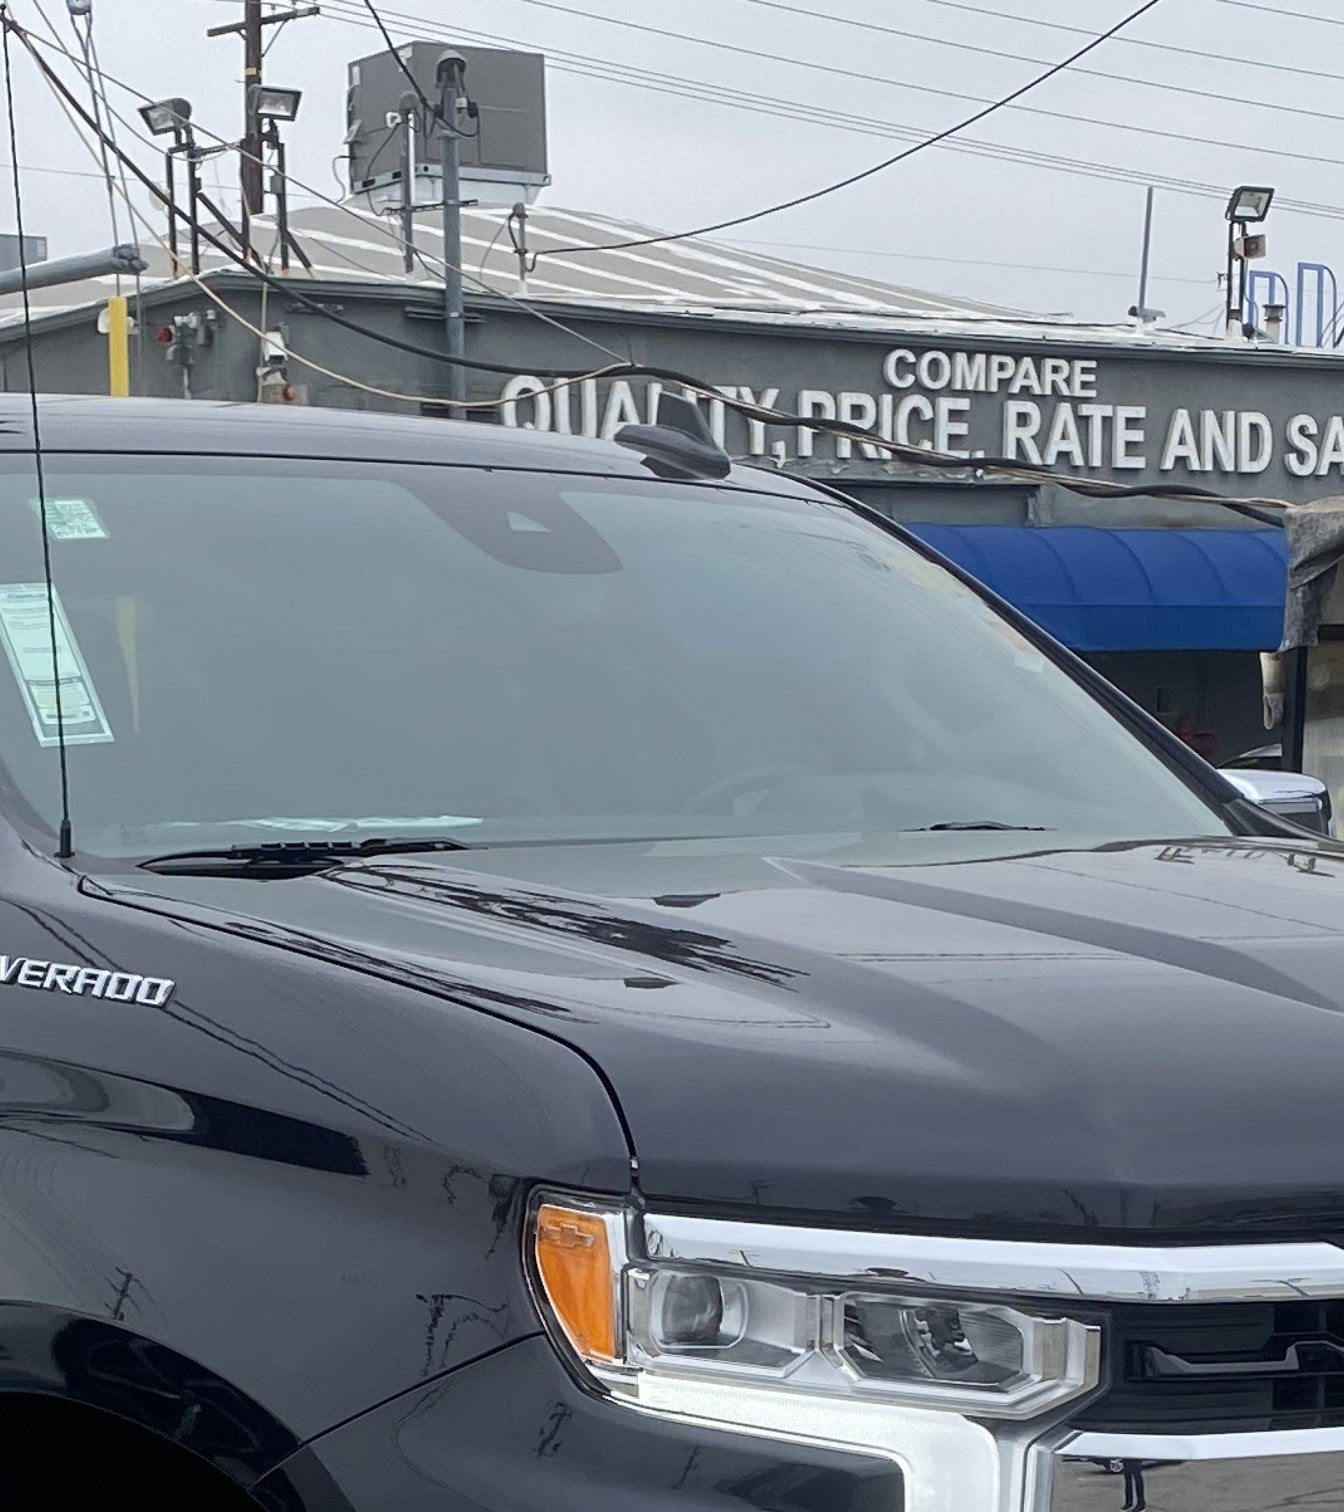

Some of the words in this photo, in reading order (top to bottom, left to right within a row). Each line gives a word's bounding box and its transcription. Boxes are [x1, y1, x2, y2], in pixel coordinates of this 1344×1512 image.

[883, 348, 1097, 398] COMPARE
[500, 374, 786, 469] QUATY,
[1002, 399, 1147, 470] RATE
[1160, 408, 1274, 474] AND
